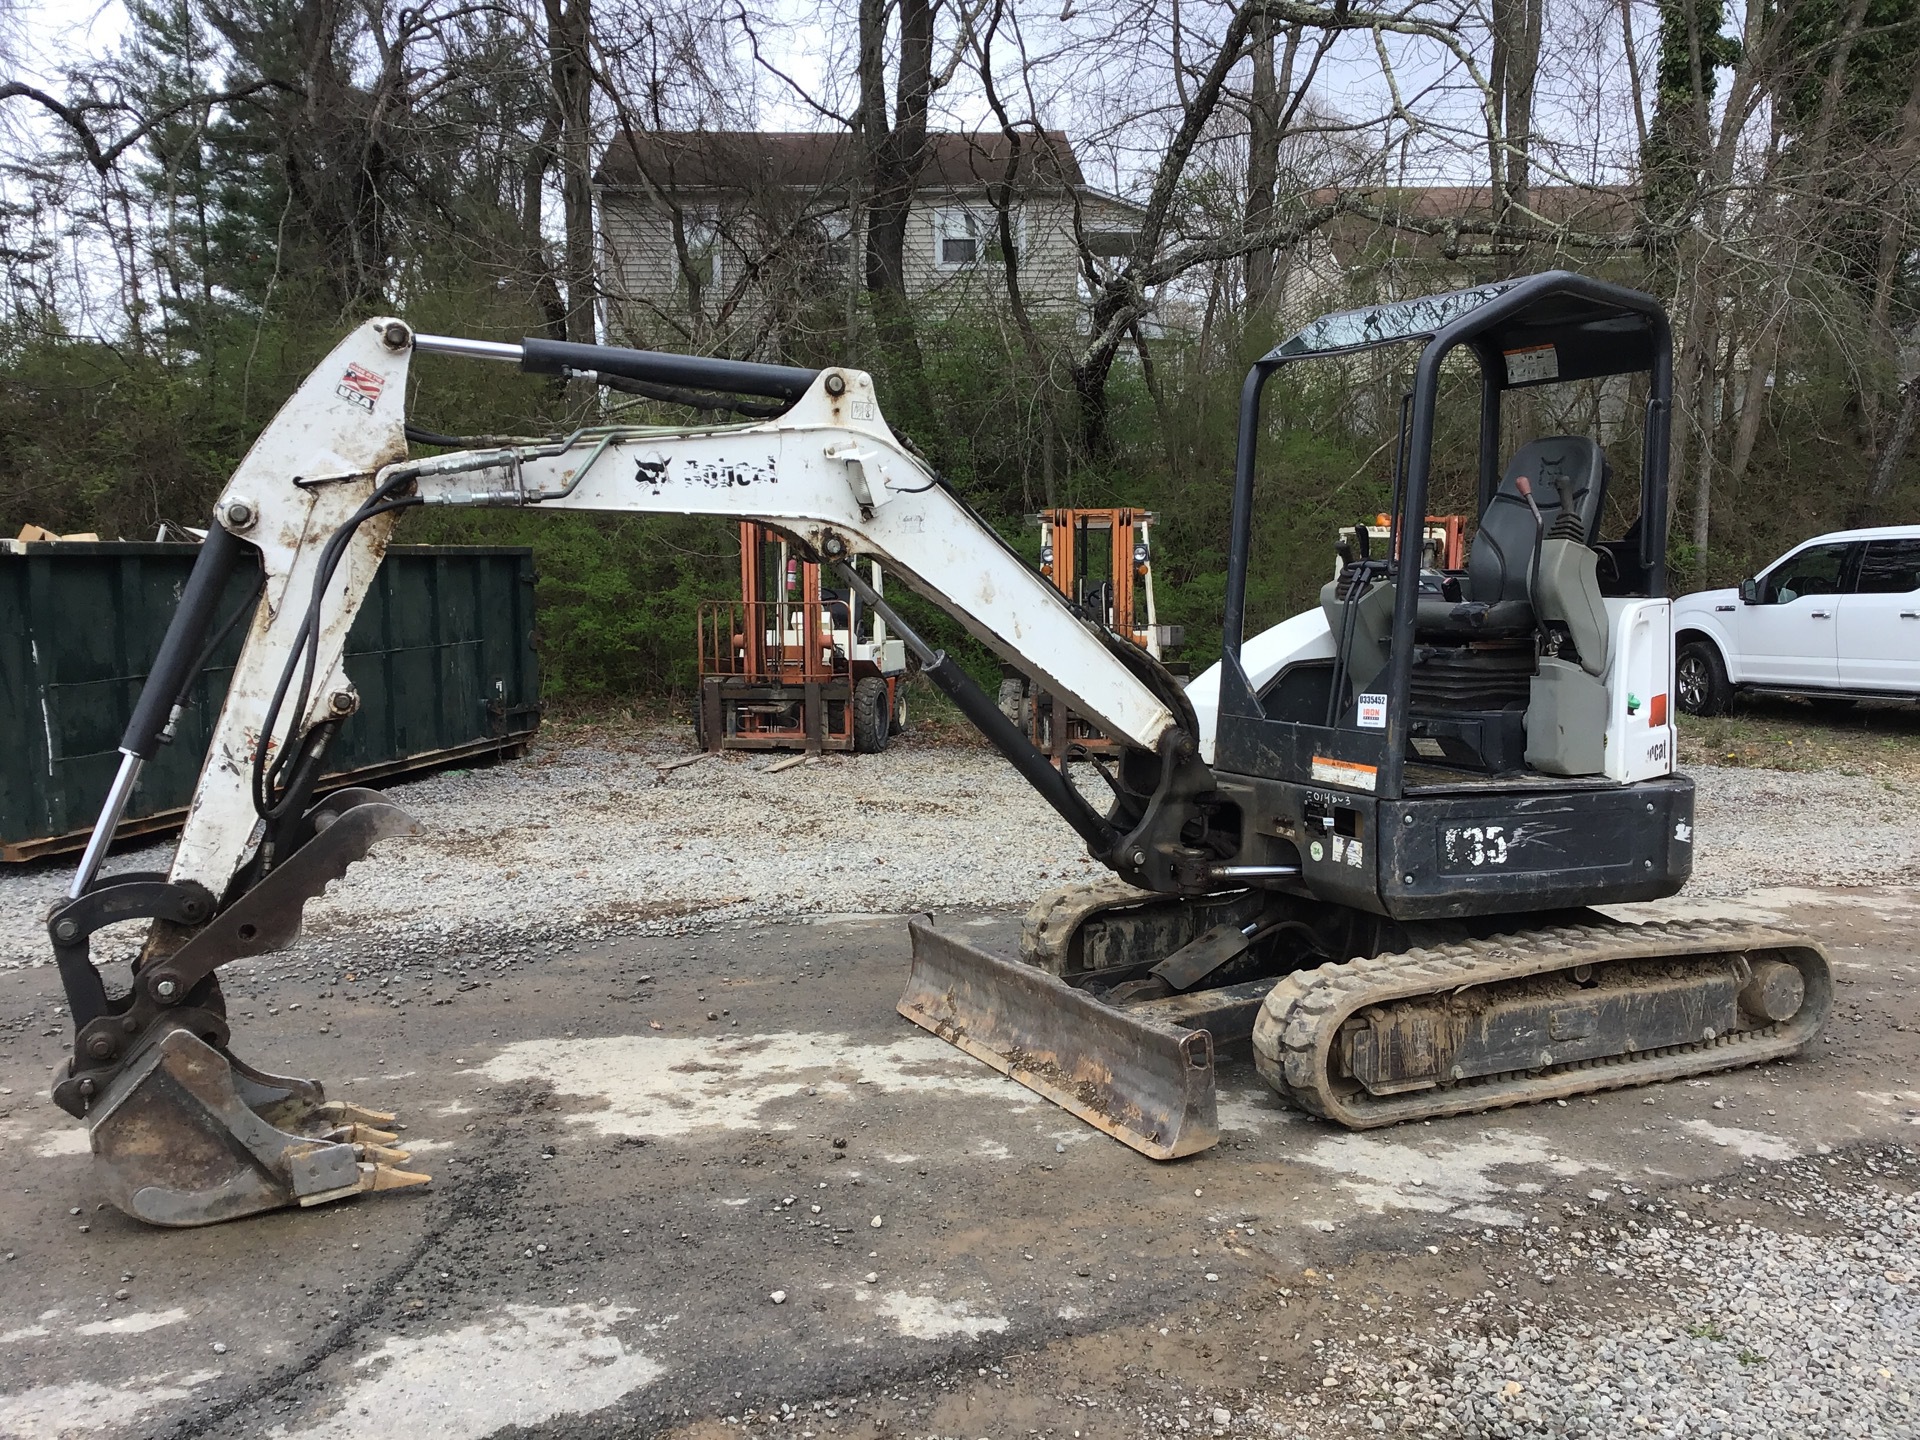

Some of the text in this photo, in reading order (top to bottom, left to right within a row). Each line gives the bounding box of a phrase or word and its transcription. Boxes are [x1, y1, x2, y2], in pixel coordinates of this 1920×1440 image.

[338, 386, 371, 409] USA
[1362, 708, 1380, 716] IRON
[1646, 739, 1667, 761] cat
